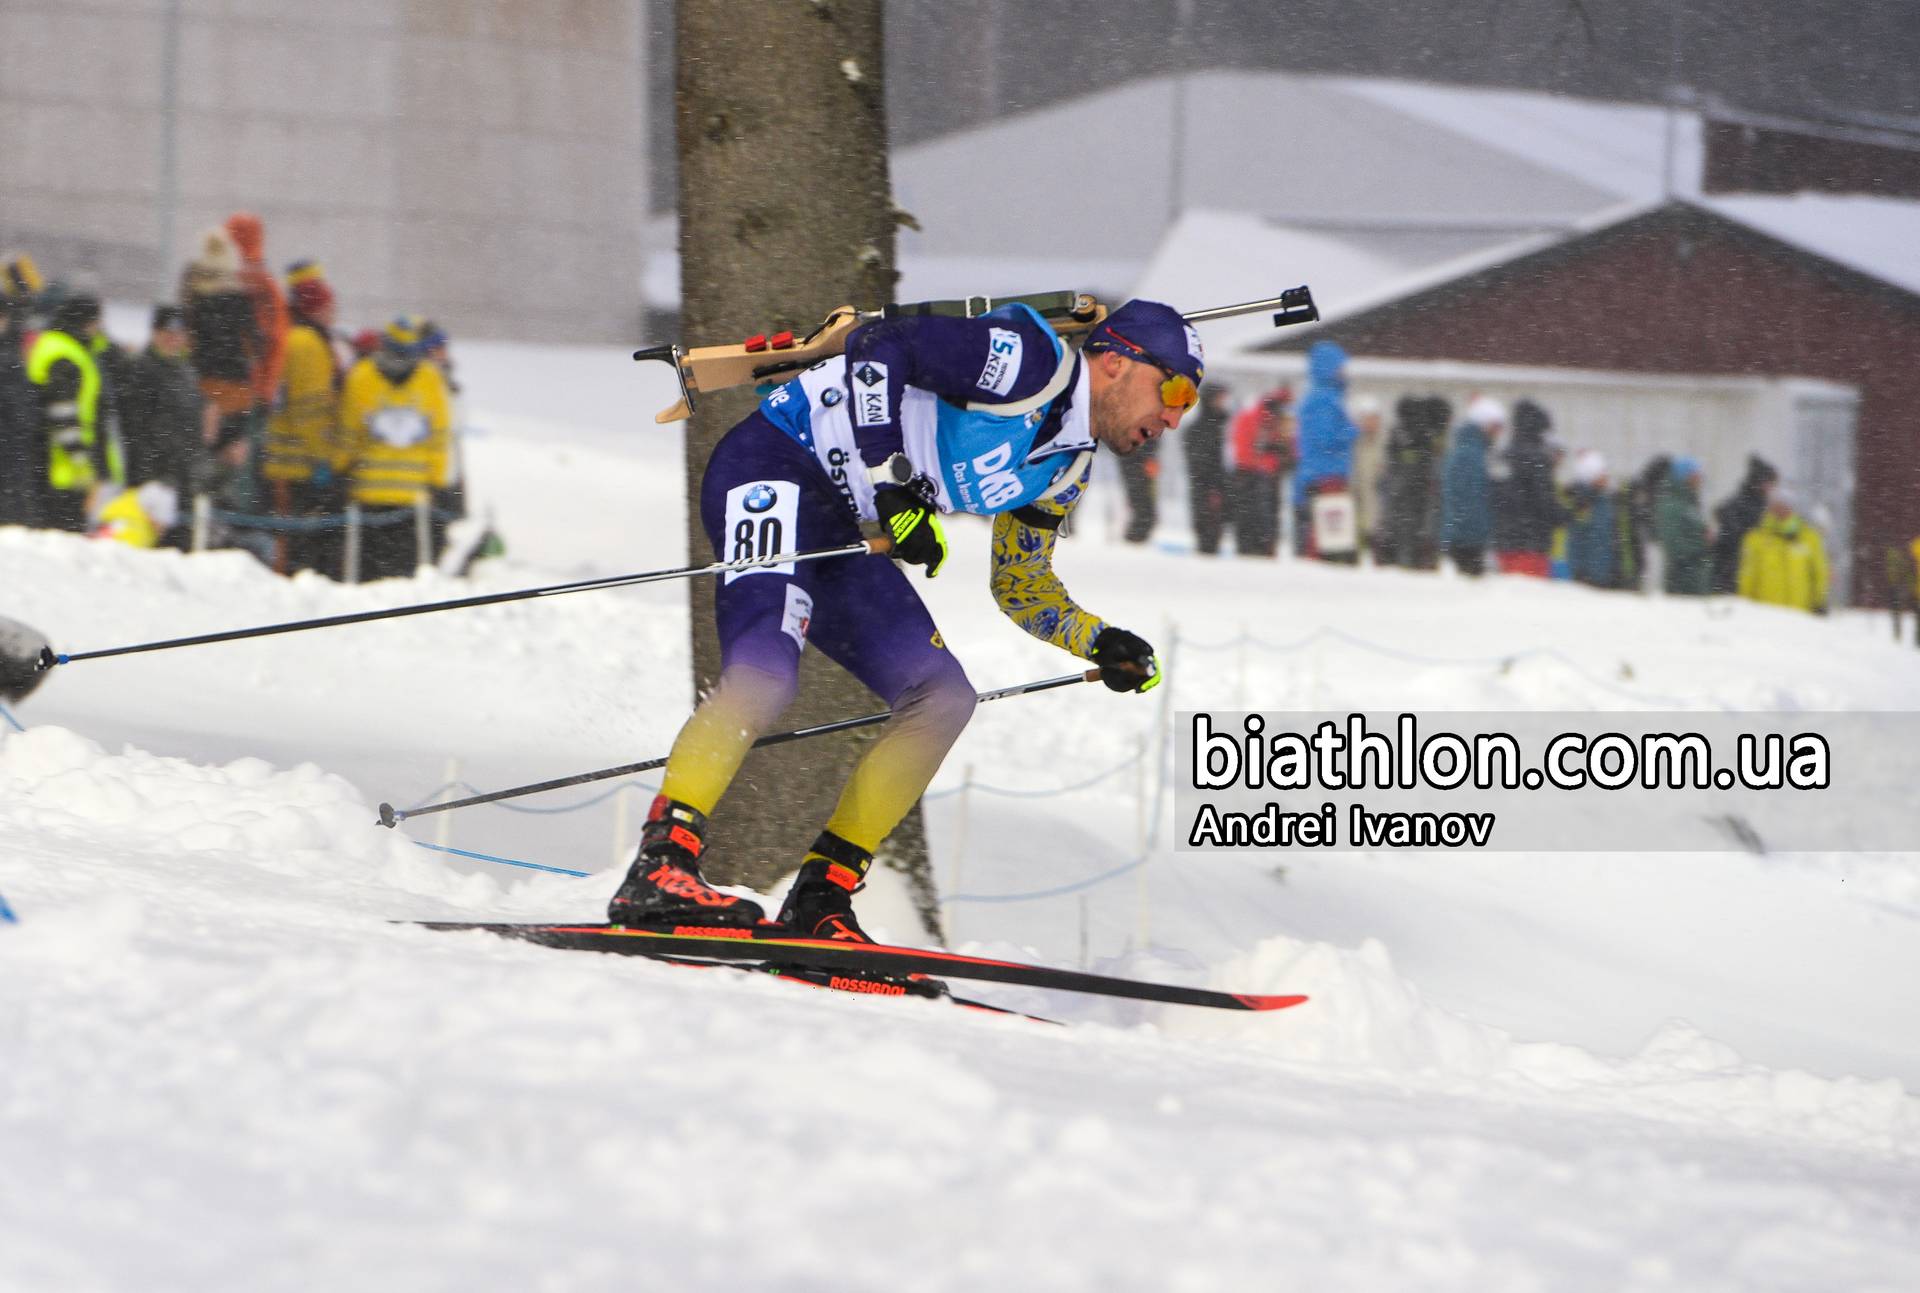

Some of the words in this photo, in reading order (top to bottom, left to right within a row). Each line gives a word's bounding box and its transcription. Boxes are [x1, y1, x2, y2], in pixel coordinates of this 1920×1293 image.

[866, 393, 885, 423] KAN
[972, 441, 1024, 509] DKB
[734, 516, 782, 573] 80
